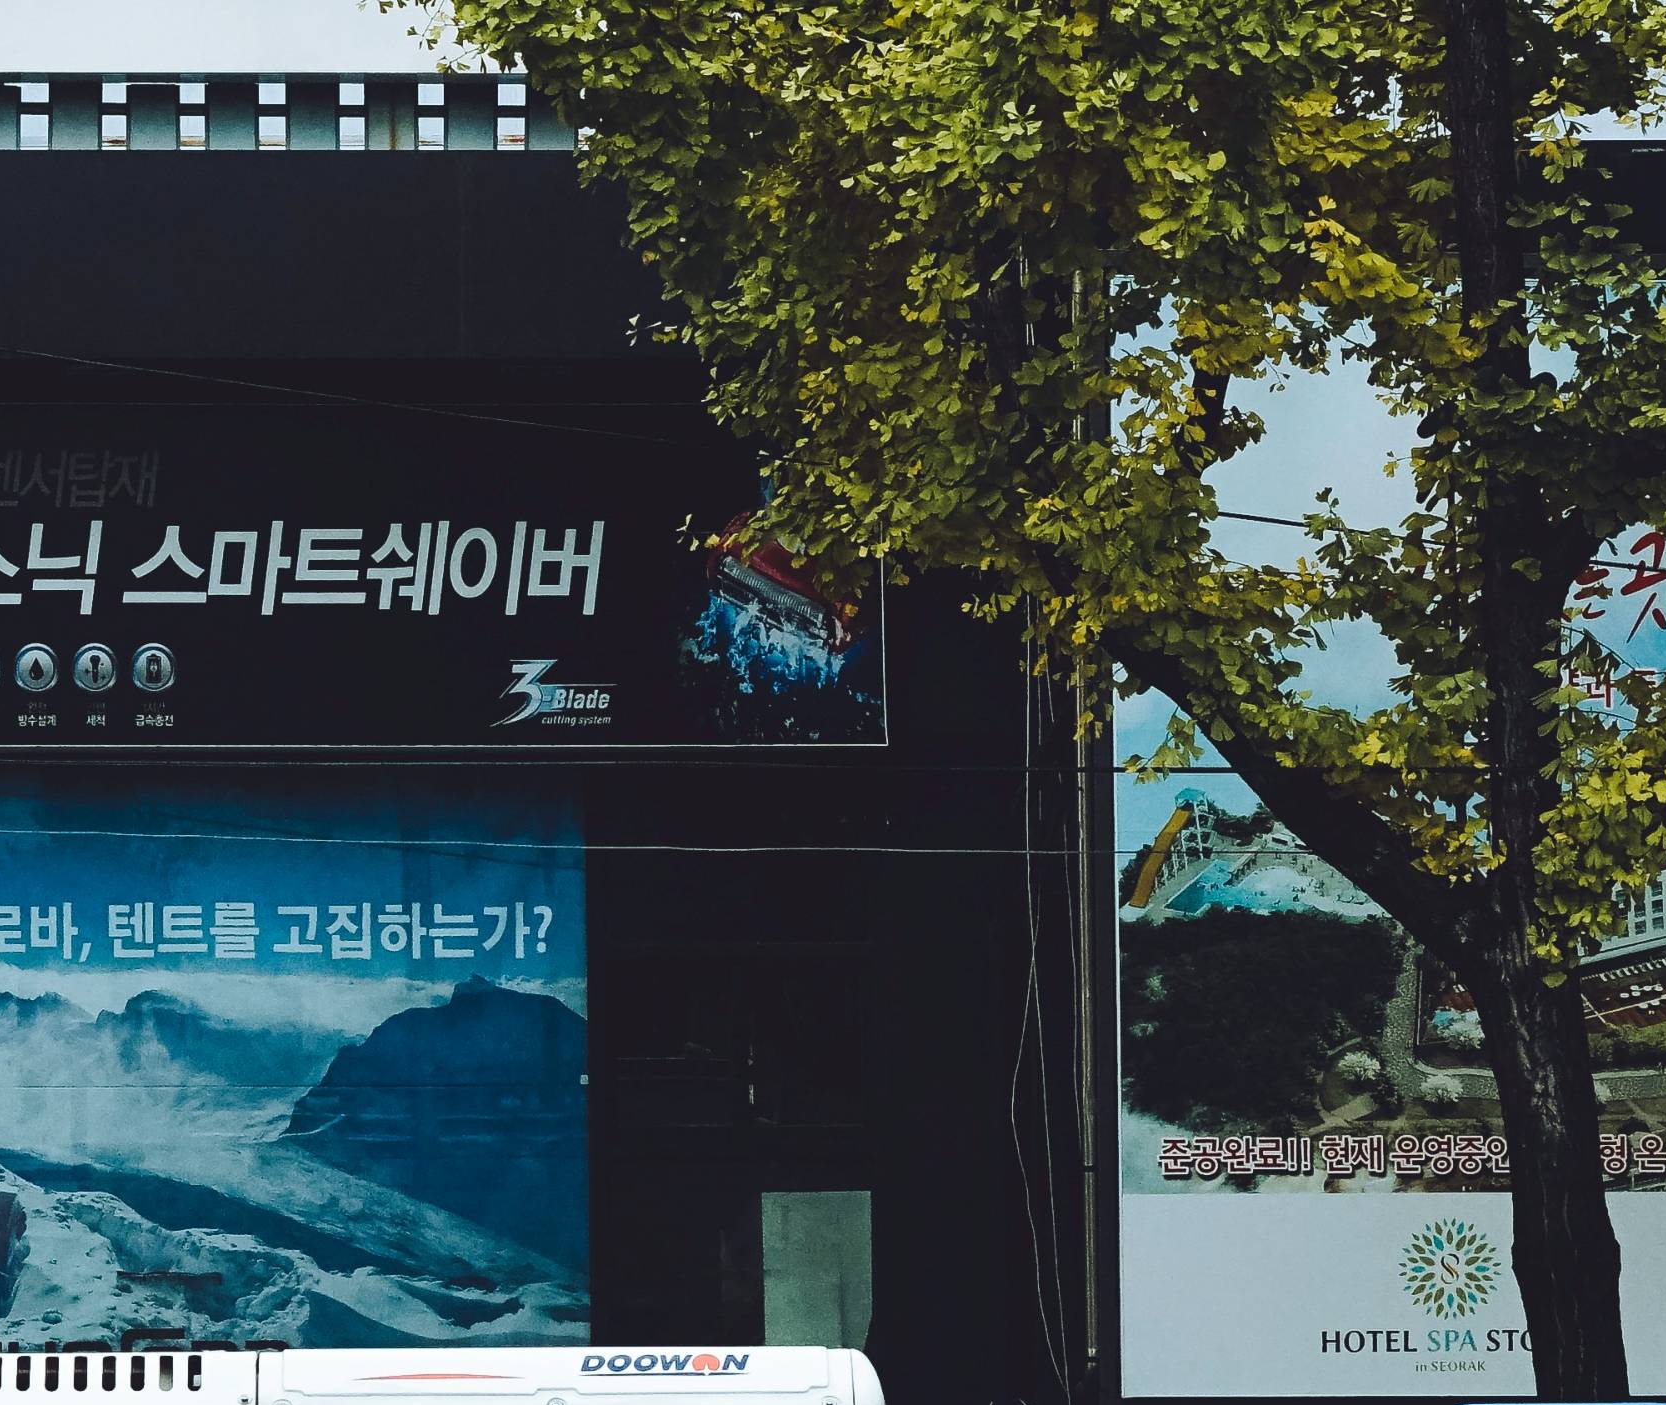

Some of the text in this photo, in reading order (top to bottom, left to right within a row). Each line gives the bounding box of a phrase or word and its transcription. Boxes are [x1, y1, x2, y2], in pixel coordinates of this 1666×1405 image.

[122, 519, 605, 616] 스마트쉐이버
[107, 902, 260, 960] 텐트를
[273, 901, 553, 961] 고집하는가?
[1157, 1134, 1311, 1176] 준공완료!!
[1318, 1134, 1385, 1176] 현재
[1321, 1329, 1418, 1353] HOTEL
[1427, 1329, 1478, 1352] SPA
[1415, 1360, 1487, 1373] in SEORAK
